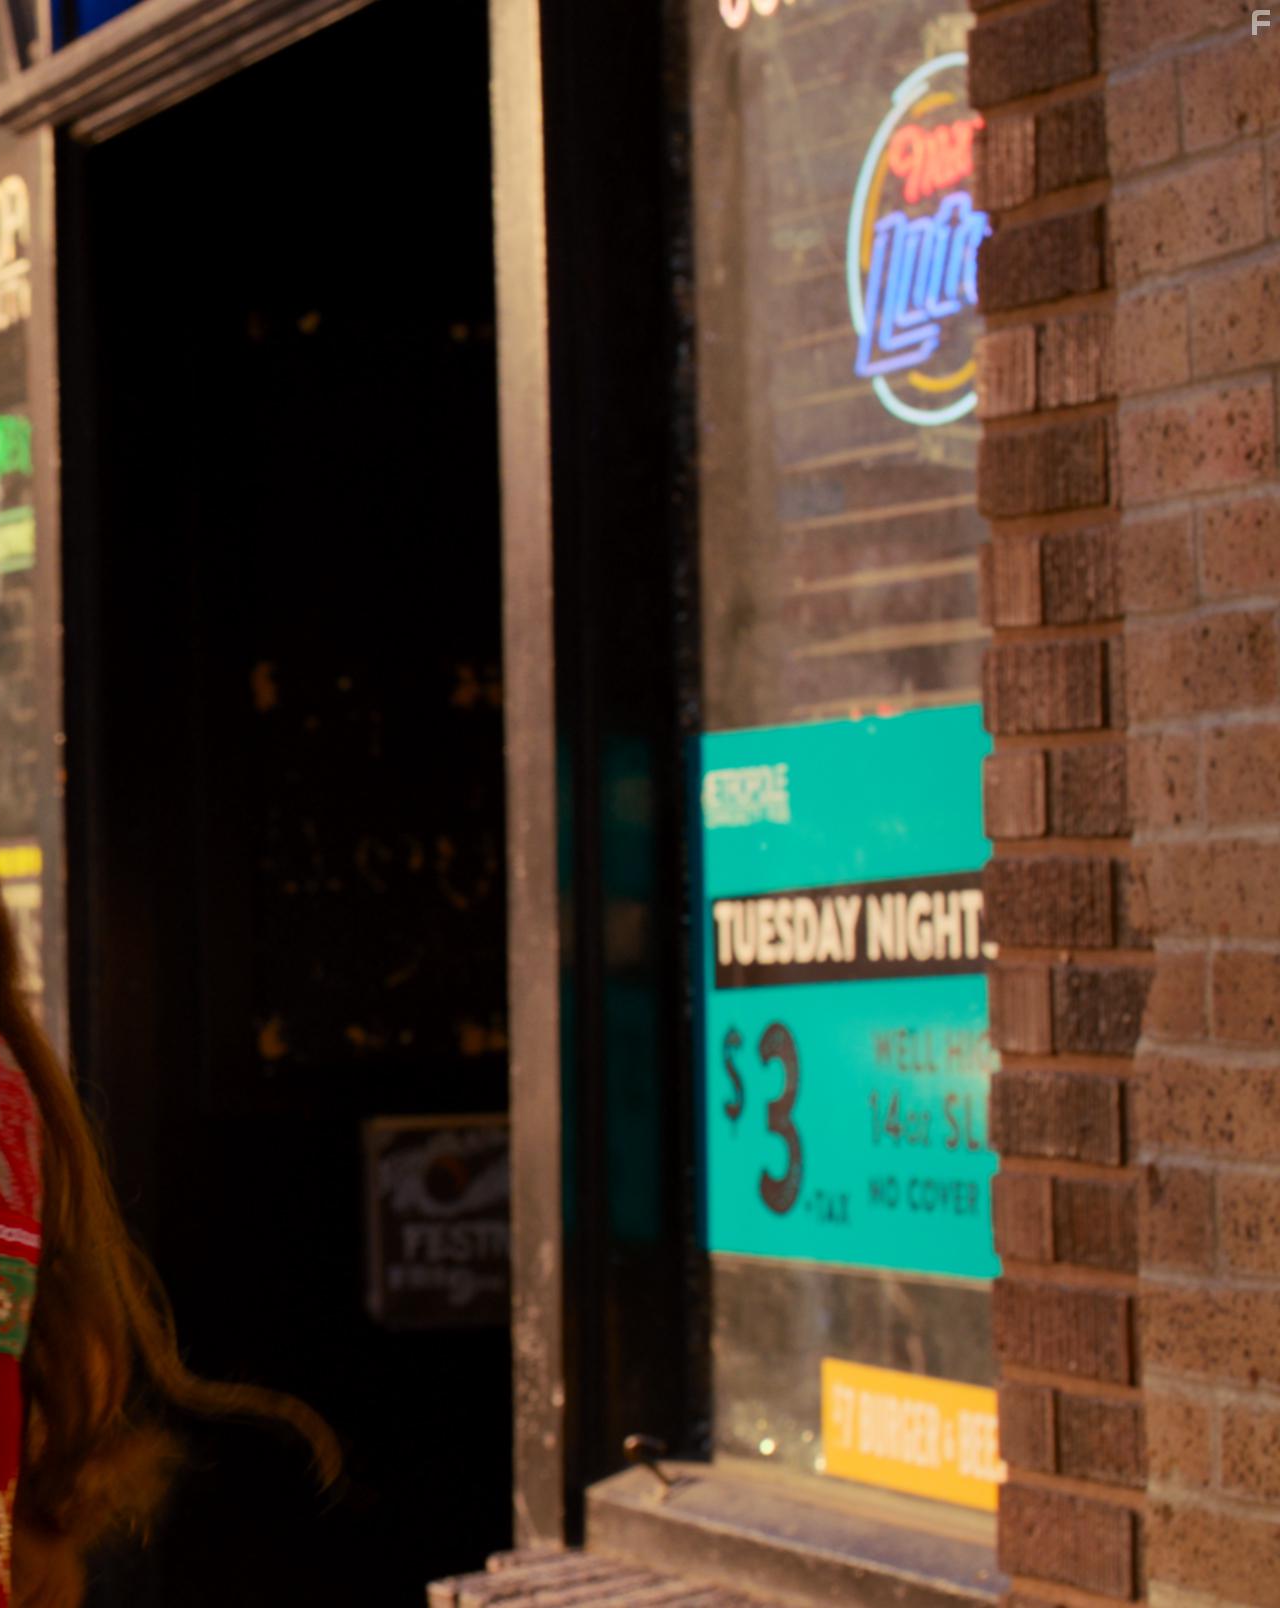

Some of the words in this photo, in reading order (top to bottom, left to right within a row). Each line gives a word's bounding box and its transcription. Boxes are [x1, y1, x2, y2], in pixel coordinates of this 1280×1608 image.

[713, 896, 861, 967] TUESDAY
[865, 888, 999, 962] NIGHT
[868, 1173, 900, 1211] NO
[906, 1175, 980, 1217] COVER
[858, 1391, 941, 1471] BURGER
